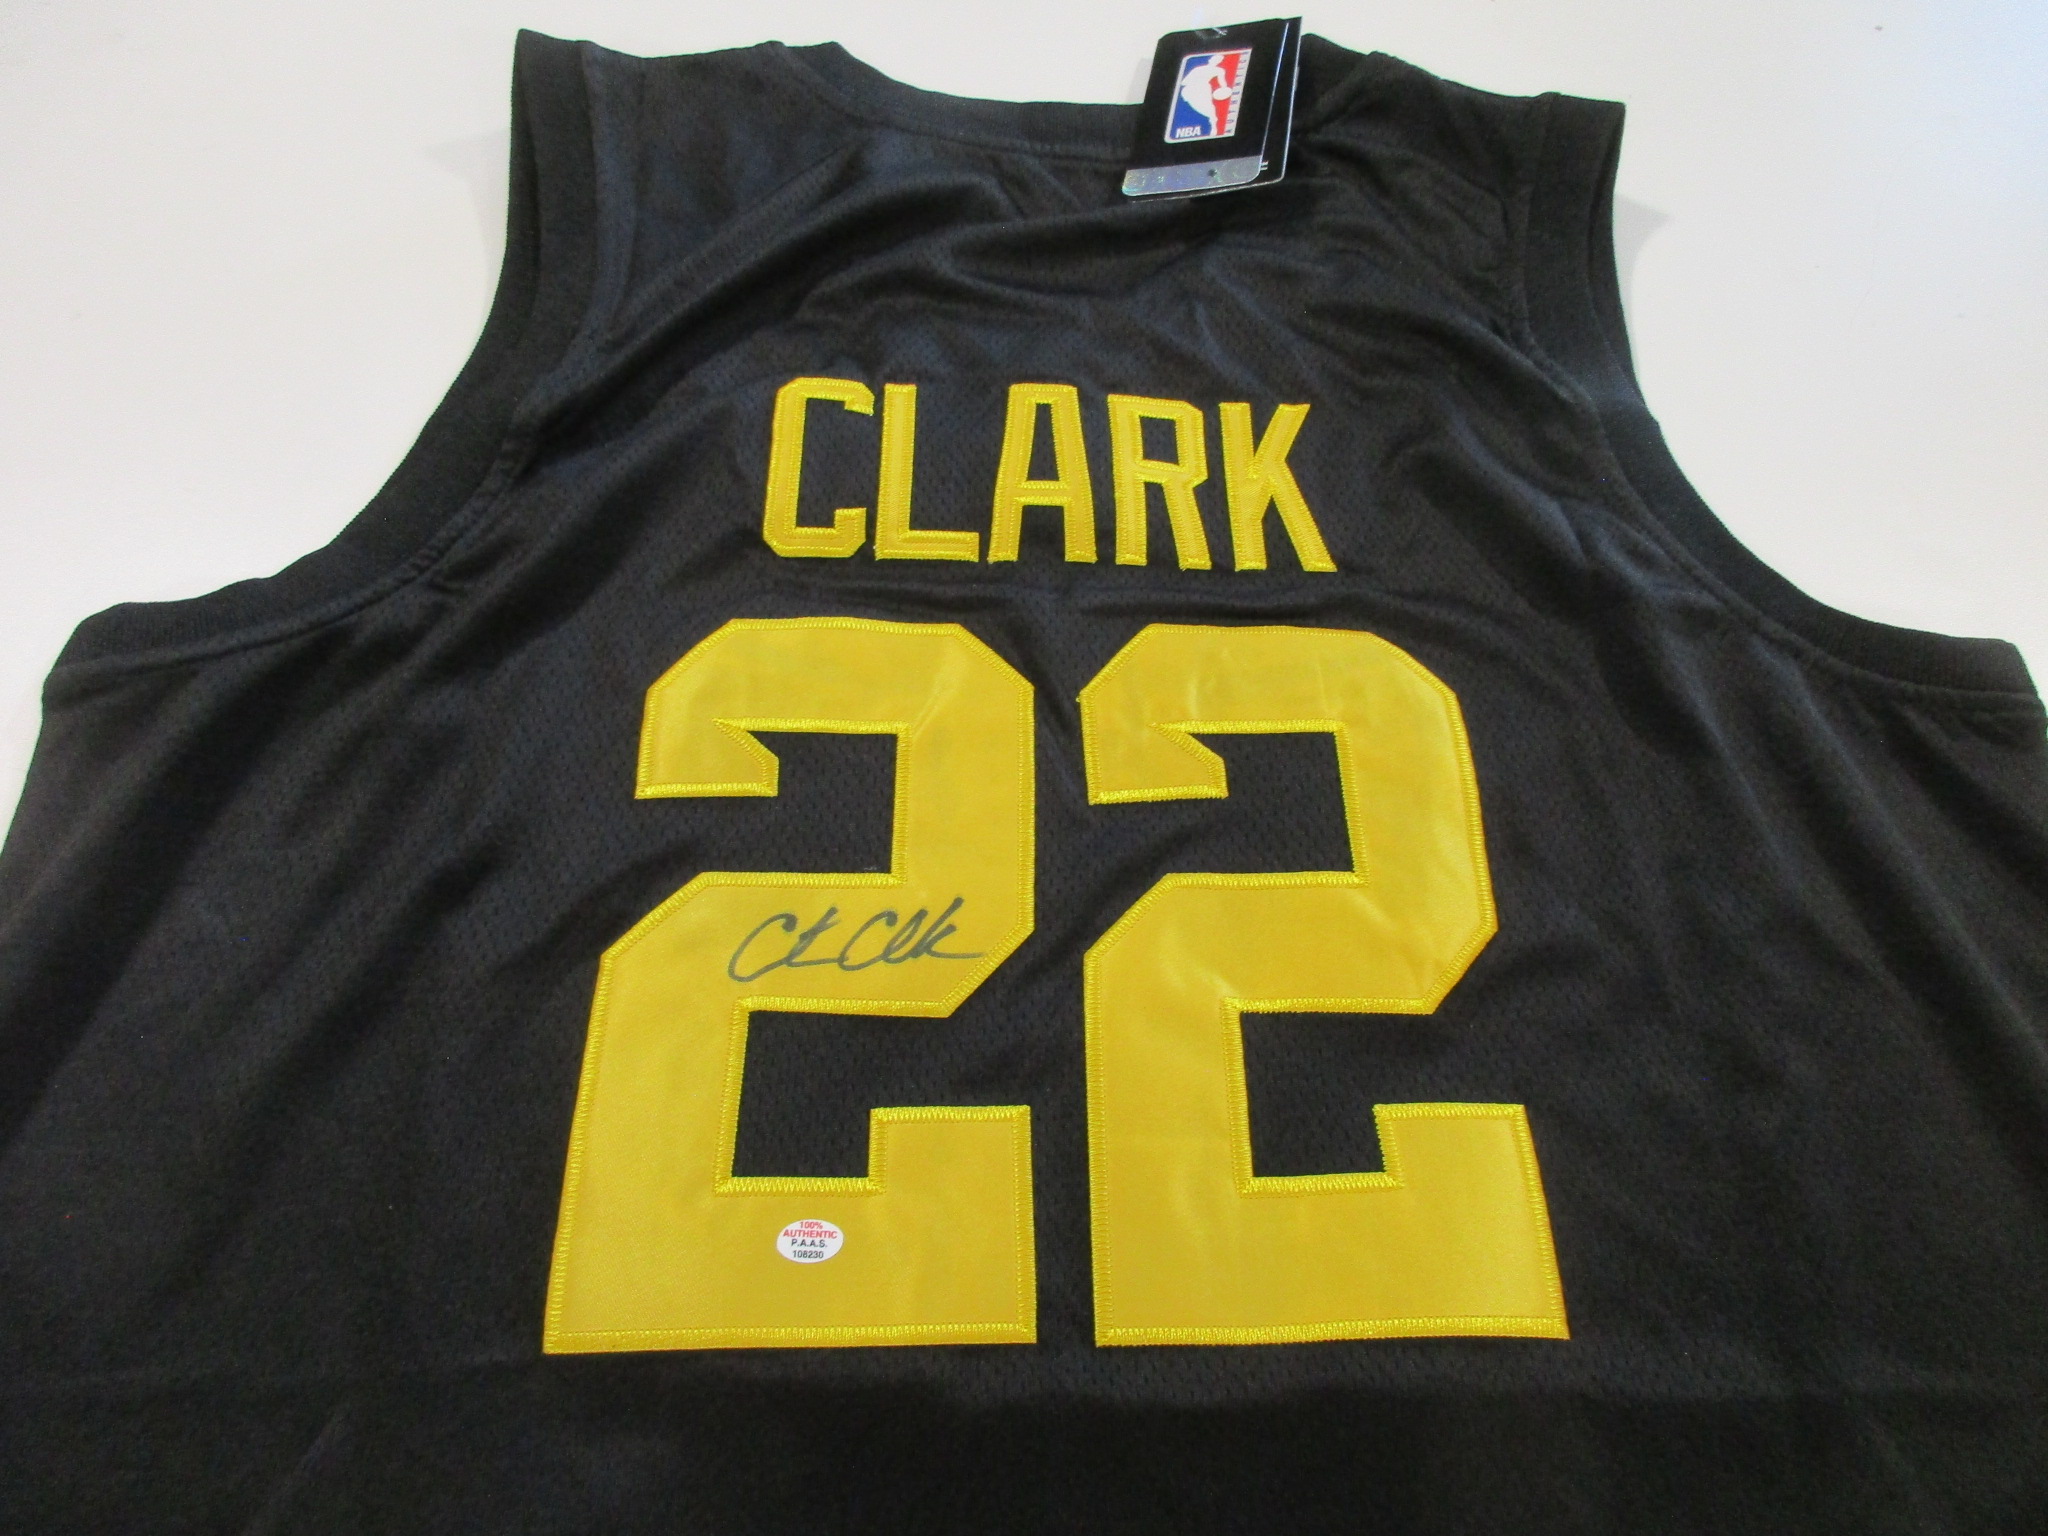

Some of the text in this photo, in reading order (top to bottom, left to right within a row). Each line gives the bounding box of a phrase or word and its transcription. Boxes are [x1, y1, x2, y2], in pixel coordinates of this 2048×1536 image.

[1175, 126, 1201, 139] NBA
[762, 376, 1338, 573] CLARK
[543, 616, 1570, 1354] 22
[800, 1221, 823, 1229] 100%
[783, 1229, 838, 1239] AUTHENTIC
[791, 1238, 828, 1248] P.A.A.S.
[792, 1250, 824, 1259] 108230
